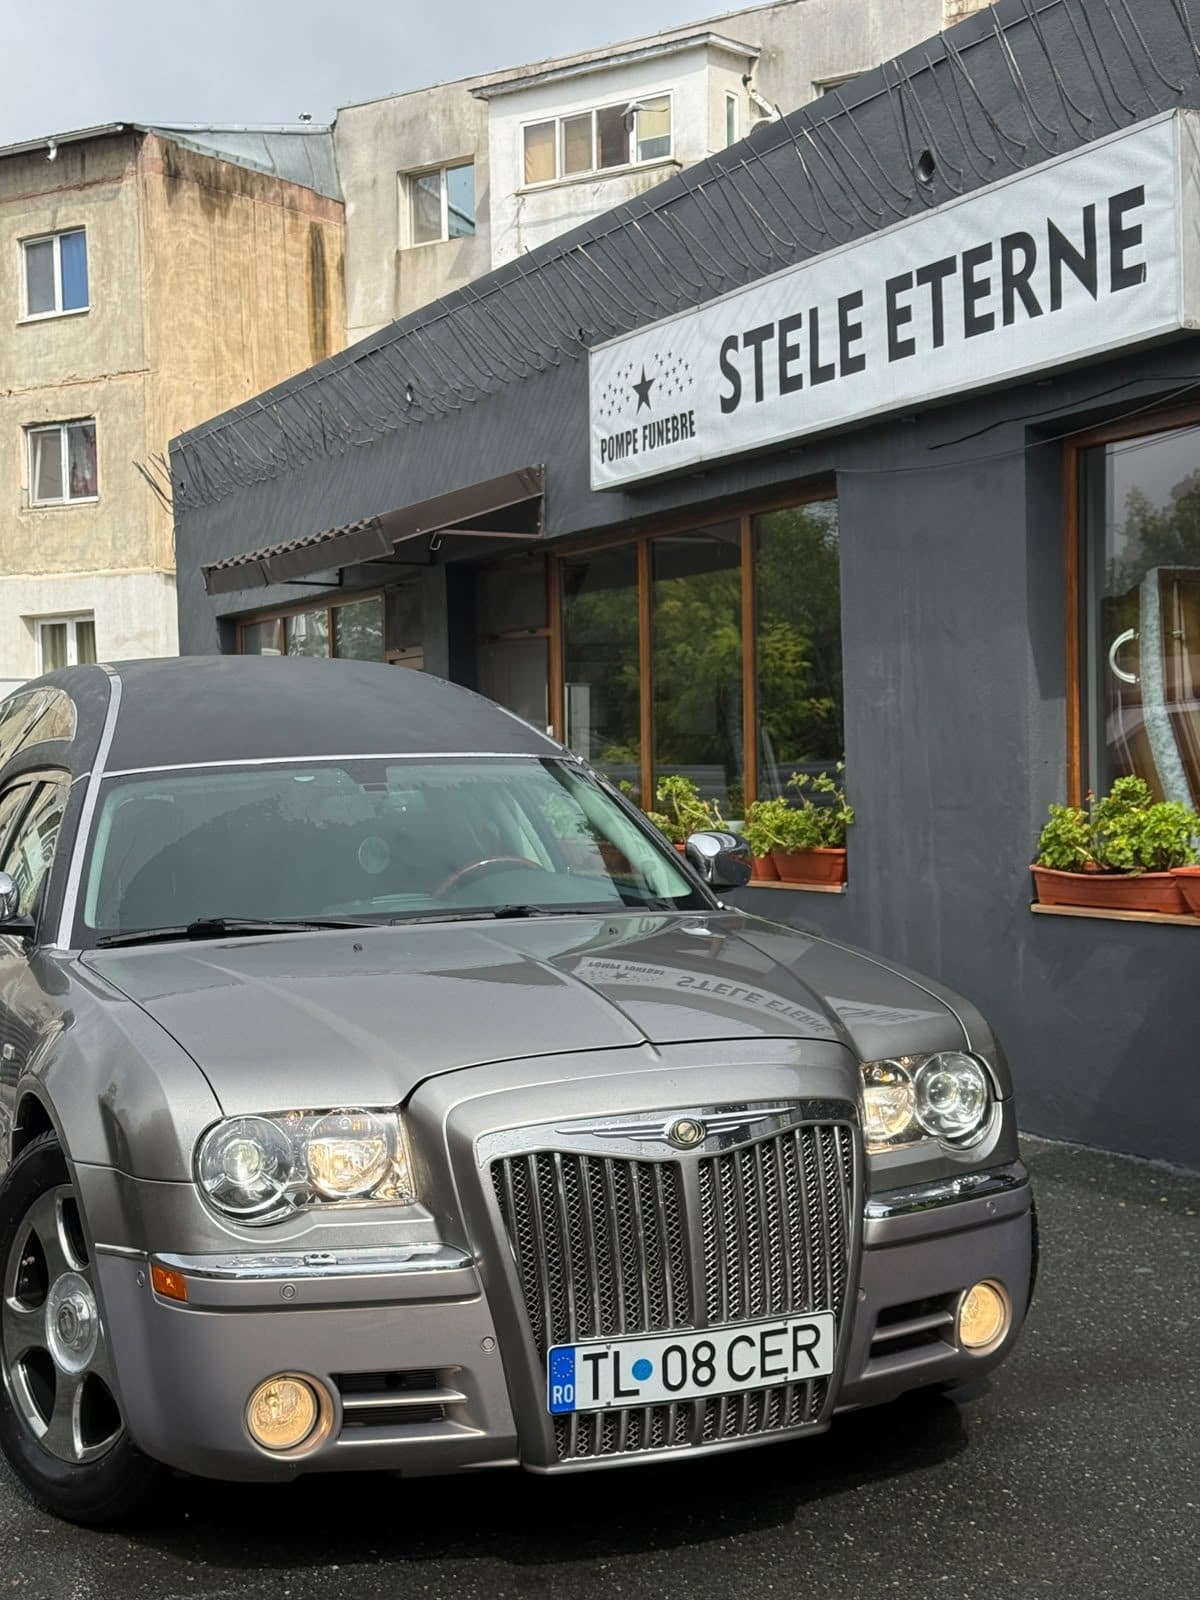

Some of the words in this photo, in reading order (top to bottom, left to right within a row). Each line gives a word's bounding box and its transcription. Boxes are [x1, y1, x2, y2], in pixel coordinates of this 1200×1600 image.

[719, 289, 867, 415] STELE
[885, 184, 1148, 363] ETERNE
[600, 428, 639, 465] POMPE
[642, 409, 697, 452] FUNEBRE
[552, 1384, 574, 1405] RO
[583, 1351, 640, 1401] TL
[661, 1340, 716, 1392] 08
[726, 1323, 821, 1382] CER
